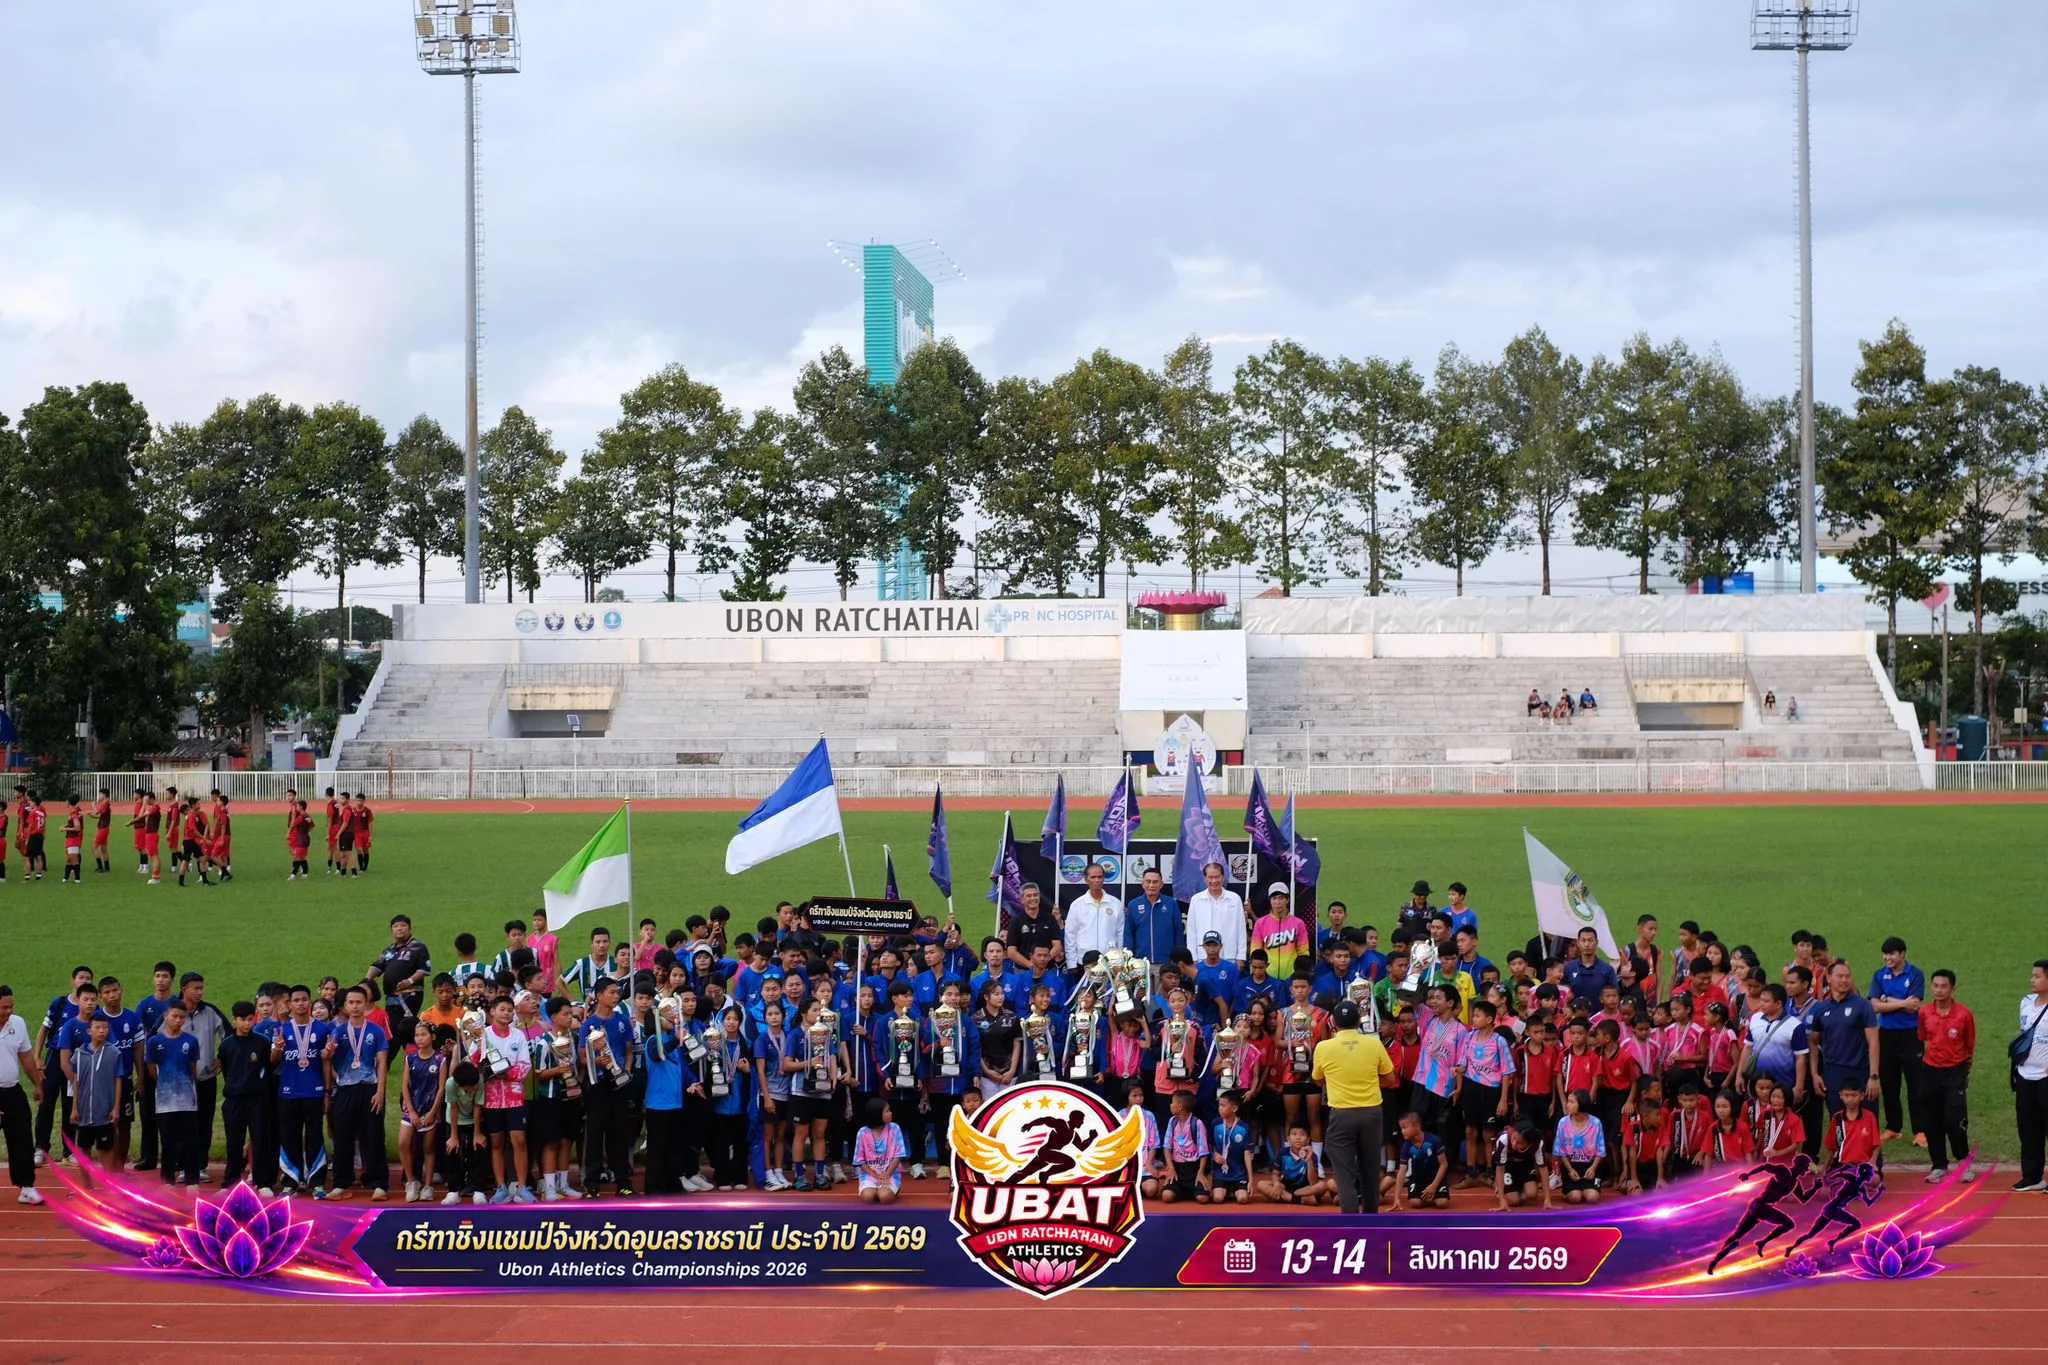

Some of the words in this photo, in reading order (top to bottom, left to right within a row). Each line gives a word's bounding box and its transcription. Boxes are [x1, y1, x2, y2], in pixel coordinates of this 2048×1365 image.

[726, 608, 803, 632] UBON
[1058, 609, 1119, 621] HOSPITAL
[1264, 928, 1296, 948] UBN
[1504, 1173, 1512, 1185] 6
